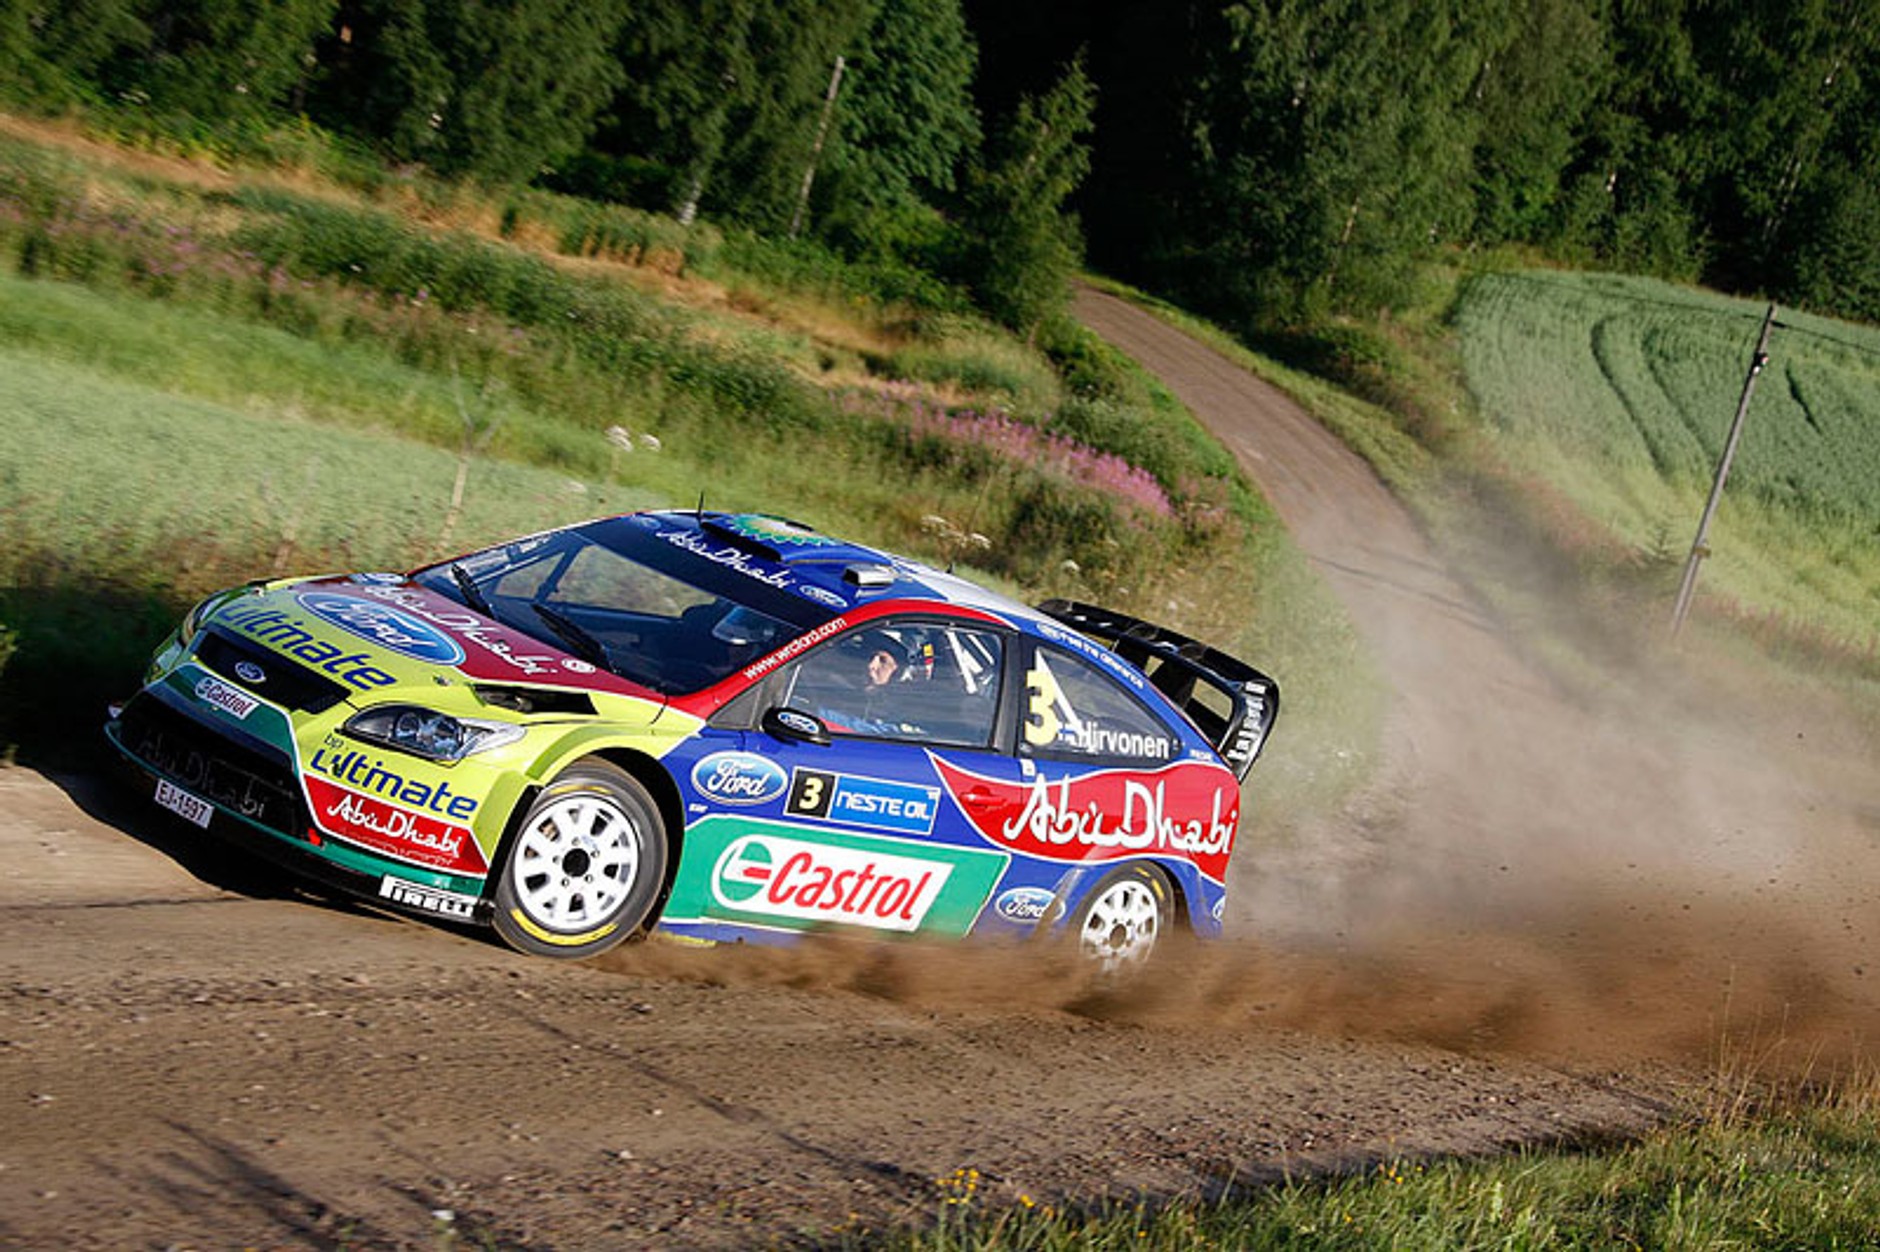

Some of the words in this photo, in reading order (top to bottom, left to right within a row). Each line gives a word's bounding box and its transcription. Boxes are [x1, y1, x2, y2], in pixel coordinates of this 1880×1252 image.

[656, 529, 712, 561] Abu
[713, 548, 797, 589] Dhabi
[217, 602, 397, 691] ultimate
[315, 601, 438, 648] Ford
[206, 682, 253, 717] Castrol
[1025, 669, 1059, 746] 3
[1079, 721, 1170, 759] Hirvonen
[310, 748, 478, 821] ultimate
[706, 758, 771, 797] Ford
[799, 777, 824, 810] 3
[835, 791, 903, 817] NESTE
[903, 801, 933, 820] OIL
[326, 794, 384, 832] Abu
[384, 810, 463, 859] Dhabi
[1002, 772, 1110, 846] Abu
[1111, 778, 1237, 855] Dhabi
[379, 873, 479, 918] PIRELLI
[767, 851, 934, 921] Castrol
